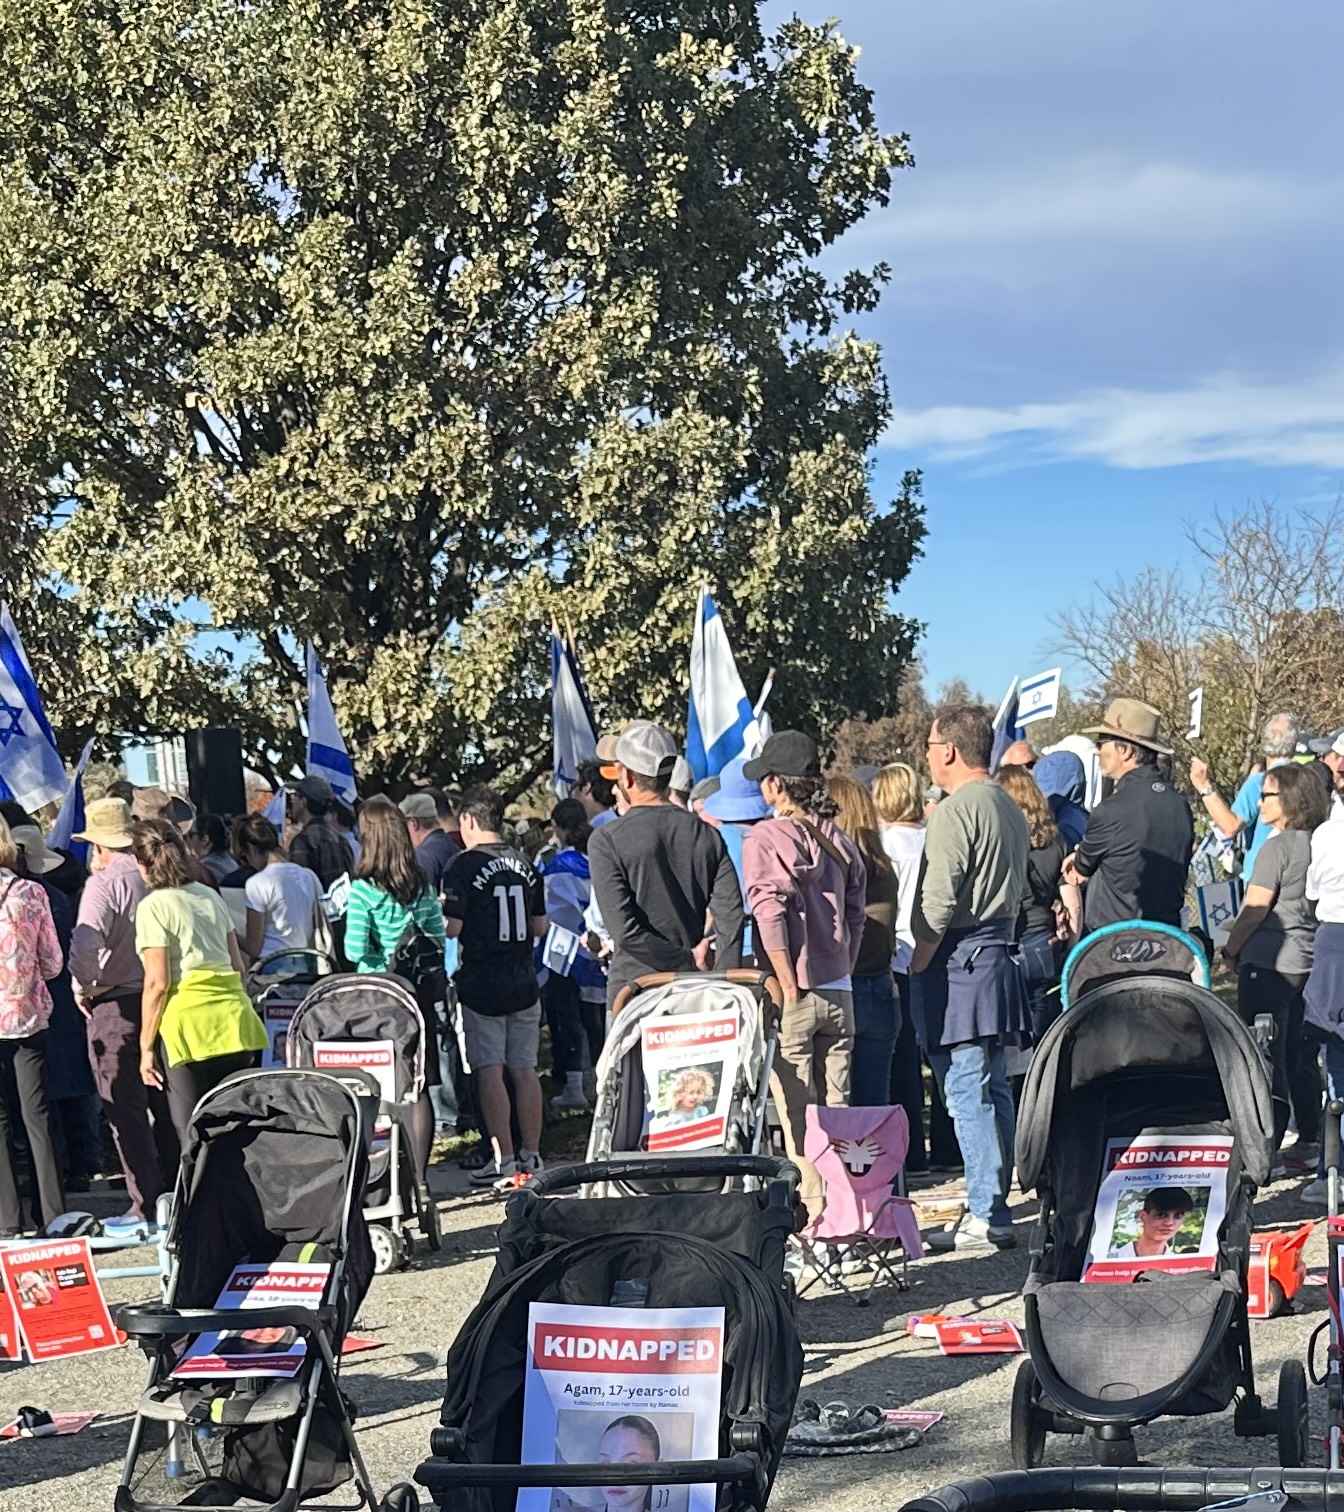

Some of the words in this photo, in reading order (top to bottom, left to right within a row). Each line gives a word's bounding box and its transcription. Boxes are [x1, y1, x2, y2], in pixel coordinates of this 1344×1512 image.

[492, 884, 527, 942] 11
[646, 1022, 735, 1045] KIDNAPPED
[318, 1051, 391, 1064] KIDNAPPED
[1114, 1149, 1231, 1165] KIDNAPPED
[8, 1243, 82, 1266] KIDNAPPED
[235, 1275, 328, 1288] KIDNAPP
[543, 1335, 716, 1362] KIDNAPPED
[563, 1382, 606, 1399] Agam,
[608, 1384, 690, 1399] 17-years-old
[886, 1412, 934, 1420] NAPPED
